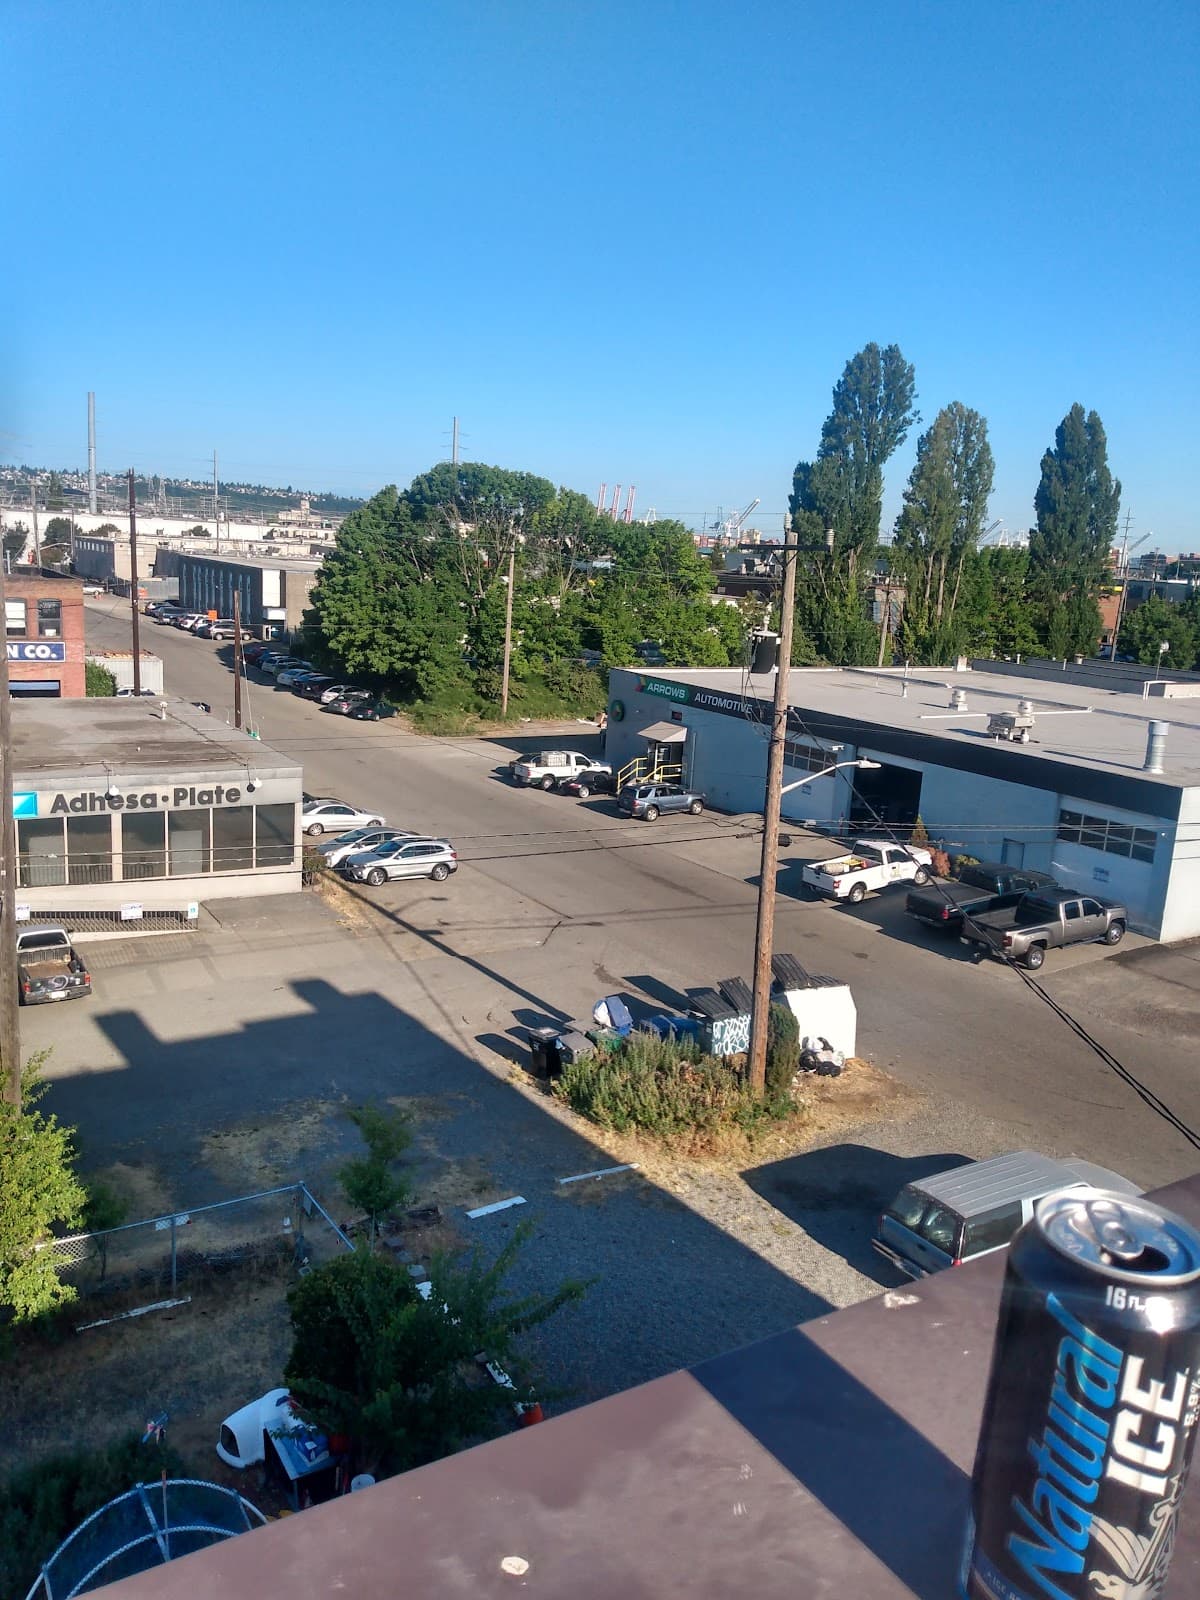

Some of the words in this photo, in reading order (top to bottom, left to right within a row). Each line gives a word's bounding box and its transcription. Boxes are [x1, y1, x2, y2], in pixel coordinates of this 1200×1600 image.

[24, 644, 57, 659] CO.
[646, 682, 685, 698] ARROWS
[694, 693, 752, 713] AUTOMOTIVE
[173, 785, 241, 807] Plate
[1105, 1285, 1128, 1310] 16
[1104, 1354, 1188, 1496] ICE
[1008, 1291, 1124, 1600] Natural
